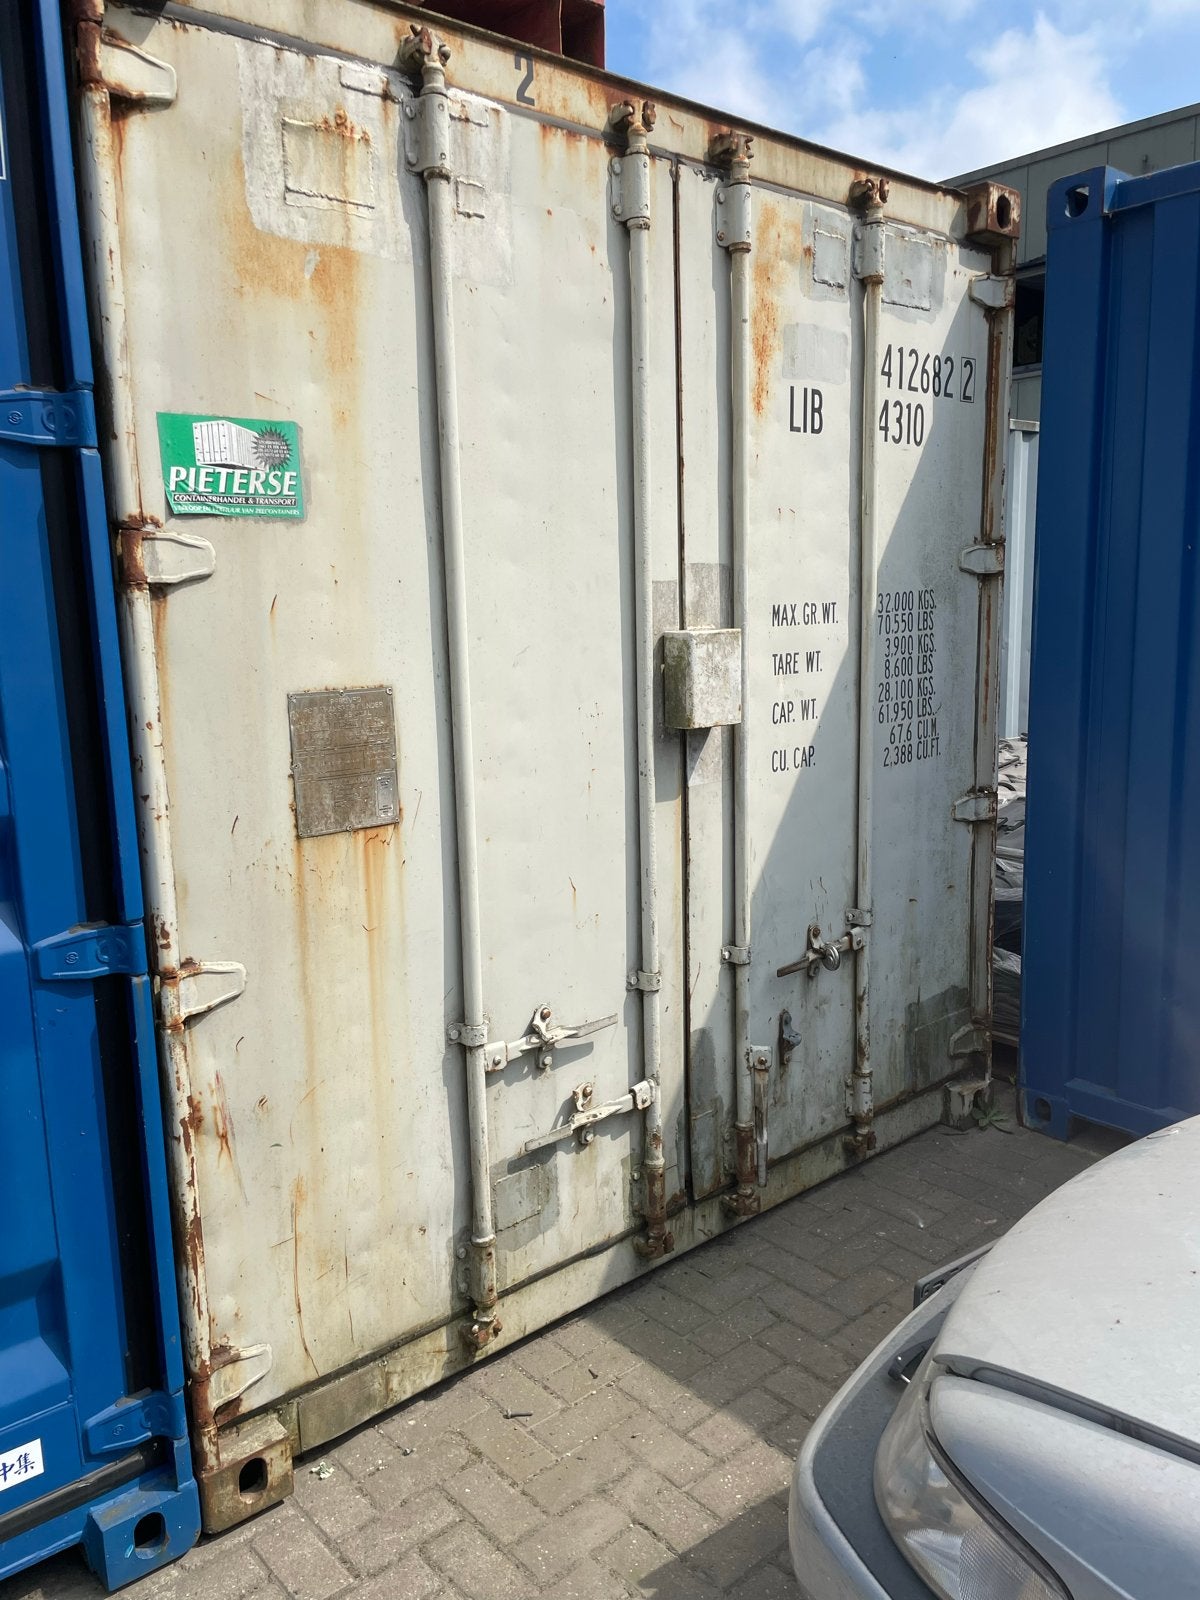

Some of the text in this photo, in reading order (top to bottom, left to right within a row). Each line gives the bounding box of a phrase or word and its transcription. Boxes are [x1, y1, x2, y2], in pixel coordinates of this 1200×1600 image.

[515, 50, 535, 106] 2
[881, 344, 974, 401] 412682 2
[789, 386, 823, 434] LIB
[879, 400, 924, 447] 4310
[169, 466, 297, 496] PIETERSE
[256, 498, 295, 506] TRANSPORT
[918, 589, 937, 610] KGS.
[772, 601, 839, 627] MAX. GR. WT.
[917, 610, 934, 631] LBS
[917, 632, 937, 654] KGS.
[772, 650, 823, 676] TARE WT.
[917, 653, 934, 675] LBS
[917, 675, 936, 698] KGS.
[772, 698, 819, 725] CAP. WT.
[889, 721, 913, 745] 67.6
[771, 745, 816, 773] CU. CAP.
[916, 736, 942, 761] CU.FT.
[0, 1452, 36, 1483] 中集
